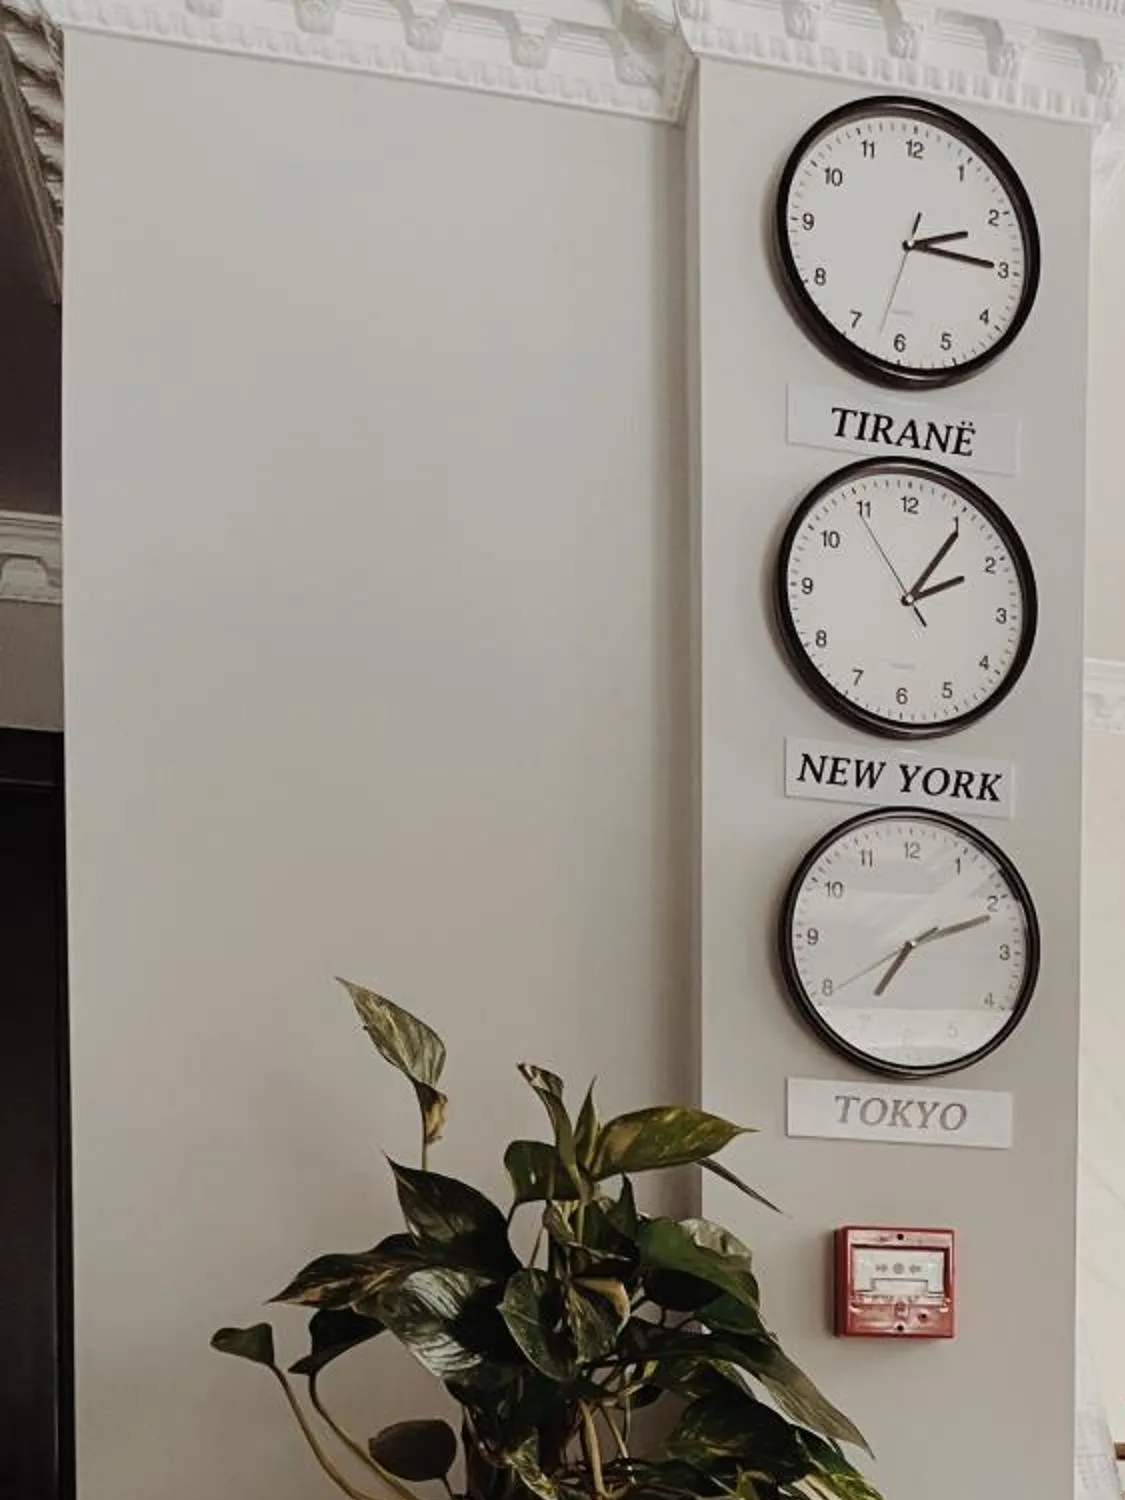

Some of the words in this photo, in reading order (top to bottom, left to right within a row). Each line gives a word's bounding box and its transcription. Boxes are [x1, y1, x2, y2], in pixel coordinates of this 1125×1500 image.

[861, 140, 875, 159] 11
[906, 139, 925, 159] 12
[824, 168, 843, 186] 10
[957, 164, 965, 182] 1
[802, 213, 815, 230] 9
[988, 209, 1000, 227] 2
[814, 268, 827, 285] 8
[997, 262, 1009, 279] 3
[850, 310, 862, 328] 7
[979, 308, 990, 324] 4
[894, 333, 906, 351] 6
[940, 333, 952, 350] 5
[831, 407, 976, 456] TIRANË
[856, 501, 871, 518] 11
[900, 496, 919, 514] 12
[822, 531, 840, 548] 10
[985, 557, 996, 574] 2
[801, 577, 813, 594] 9
[996, 608, 1007, 624] 3
[815, 630, 827, 647] 8
[979, 655, 989, 670] 4
[852, 669, 864, 686] 7
[896, 687, 908, 704] 6
[942, 681, 953, 699] 5
[796, 753, 886, 789] NEW
[899, 763, 1003, 802] YORK
[860, 850, 873, 867] 11
[904, 842, 921, 859] 12
[955, 858, 962, 875] 1
[825, 881, 843, 898] 10
[987, 895, 999, 912] 2
[807, 928, 819, 945] 9
[999, 944, 1011, 961] 3
[822, 979, 833, 997] 8
[984, 992, 995, 1008] 4
[834, 1095, 967, 1131] TOKYO
